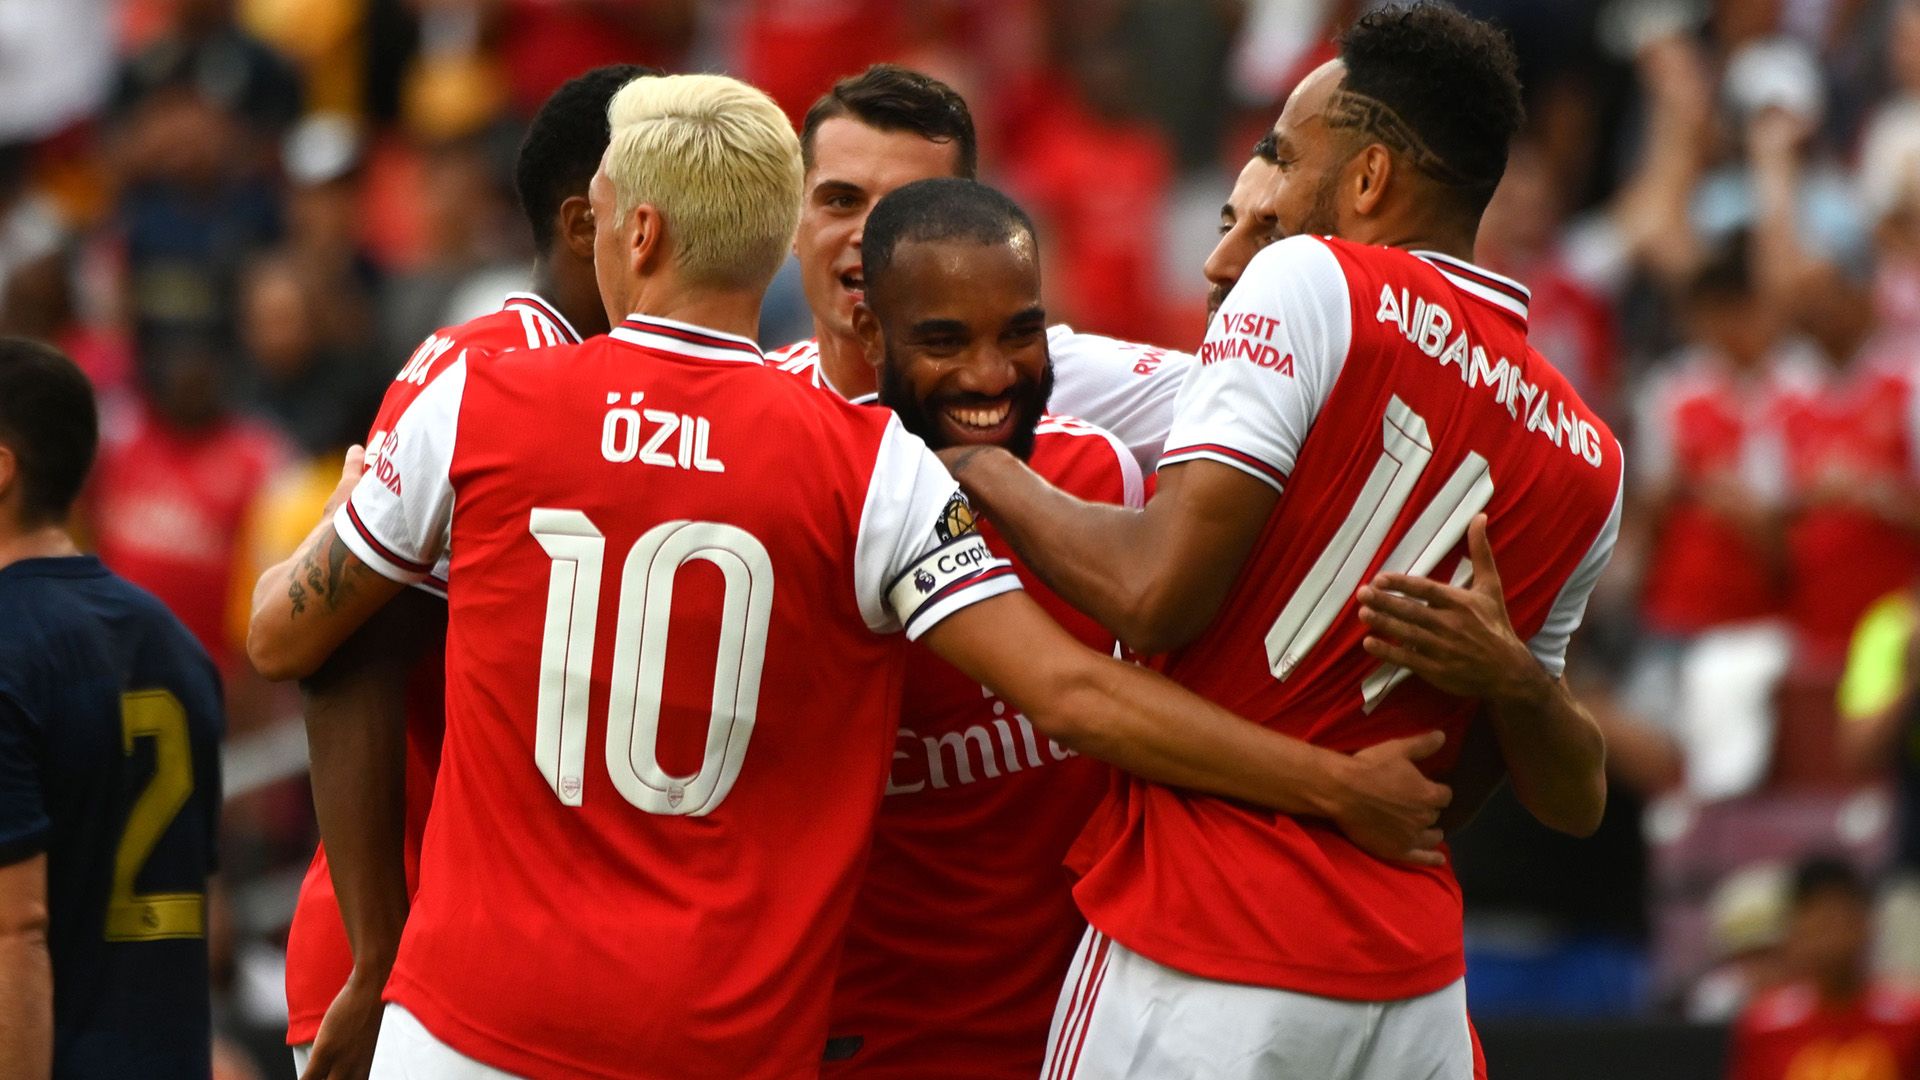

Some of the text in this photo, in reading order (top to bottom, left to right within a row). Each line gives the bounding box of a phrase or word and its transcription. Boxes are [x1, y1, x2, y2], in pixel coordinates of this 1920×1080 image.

[1201, 337, 1295, 379] RWANDA
[1222, 312, 1280, 341] VISIT
[1376, 283, 1602, 469] AUBAMEYANG
[601, 391, 726, 473] ÖZIL
[529, 507, 775, 817] 10
[104, 689, 206, 941] 2
